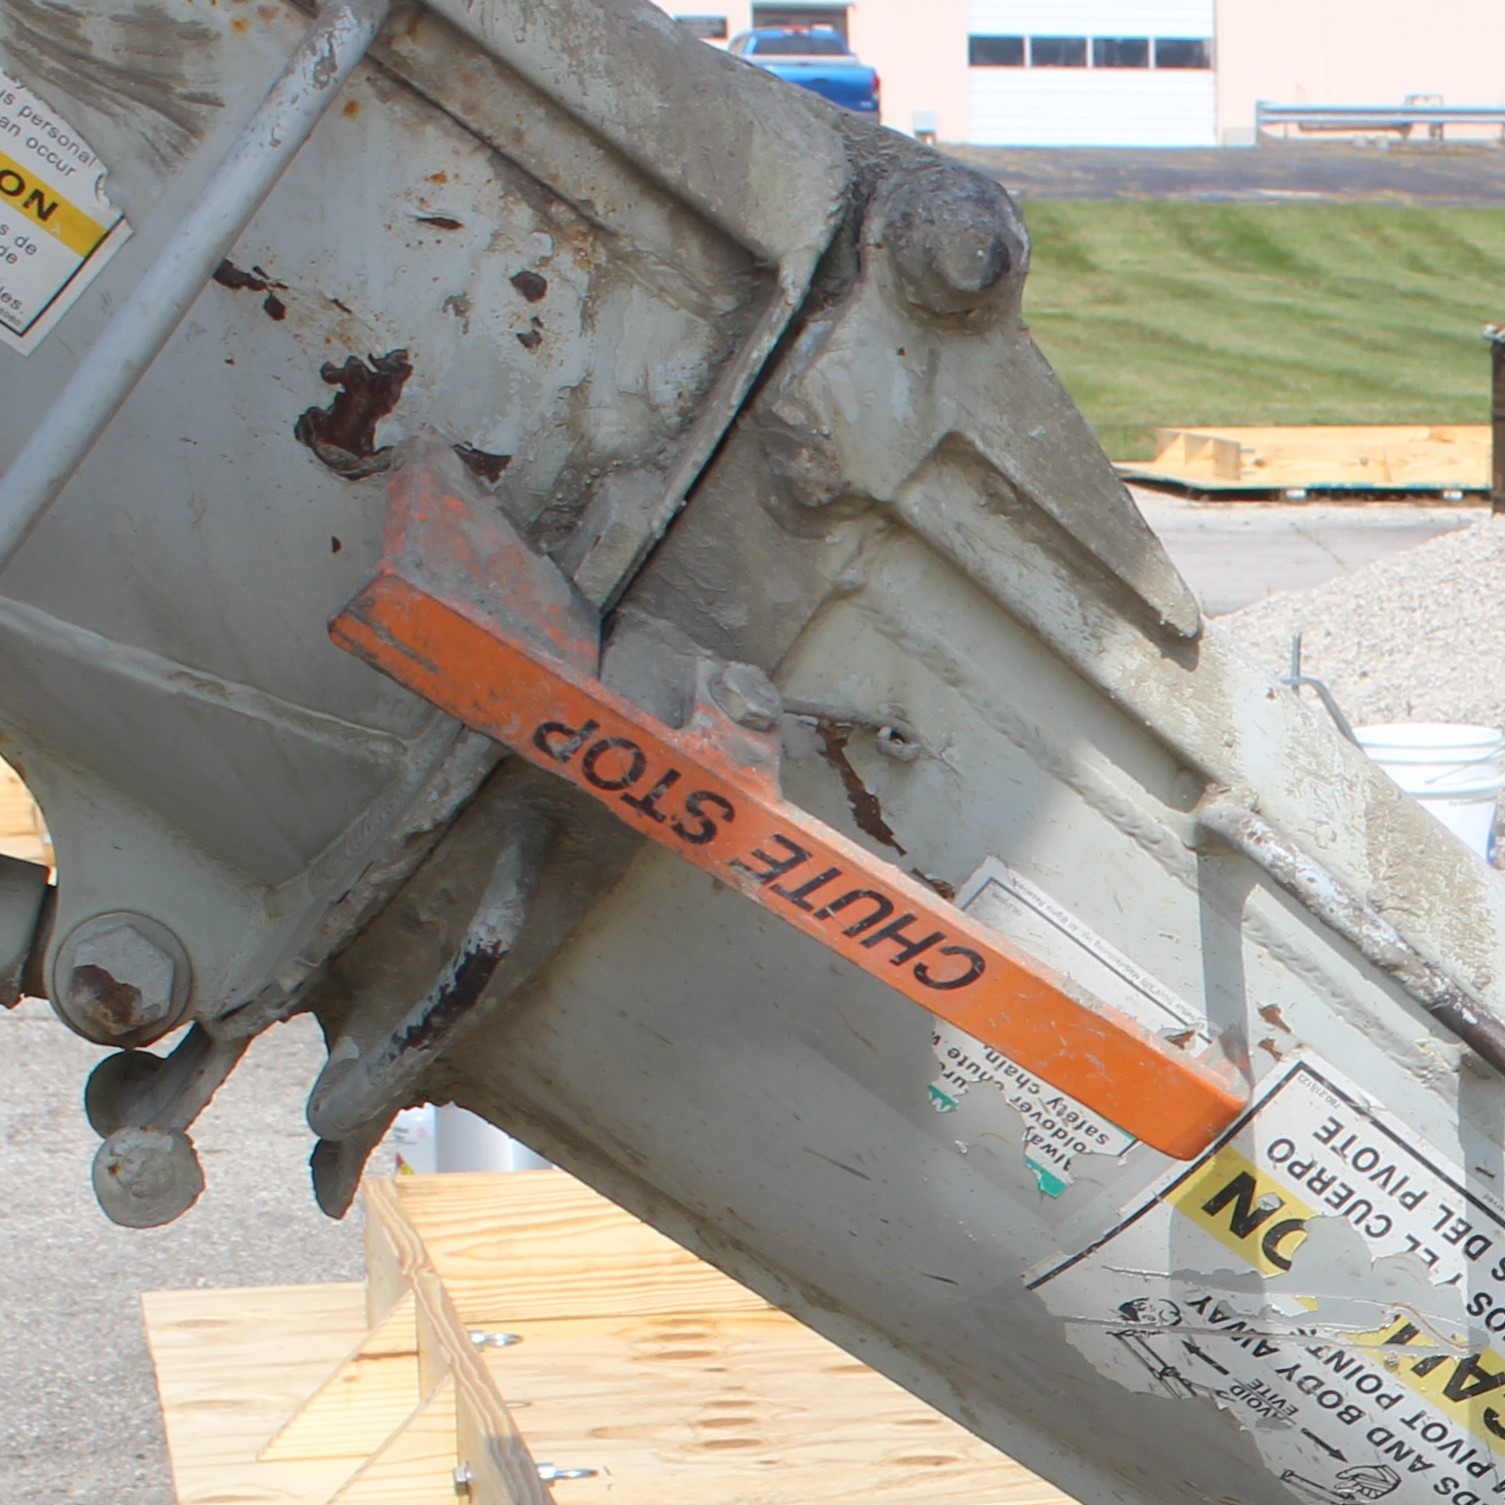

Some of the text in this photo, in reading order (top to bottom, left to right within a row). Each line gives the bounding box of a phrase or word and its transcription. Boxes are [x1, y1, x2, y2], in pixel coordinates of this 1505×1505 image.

[18, 104, 98, 168] personal
[25, 135, 77, 177] occur
[14, 234, 38, 256] de
[532, 719, 986, 991] CHUTE STOP
[1004, 1092, 1094, 1161] oldover
[1043, 1092, 1113, 1149] safety
[1260, 1131, 1399, 1244] CUERPO
[1308, 1112, 1432, 1214] PIVOTE
[1424, 1201, 1495, 1264] DEL
[1181, 1284, 1281, 1366] AWAY
[1246, 1374, 1301, 1419] EVITE
[1273, 1353, 1367, 1430] BODY
[1363, 1421, 1435, 1481] AND
[1399, 1402, 1497, 1482] PIVOT
